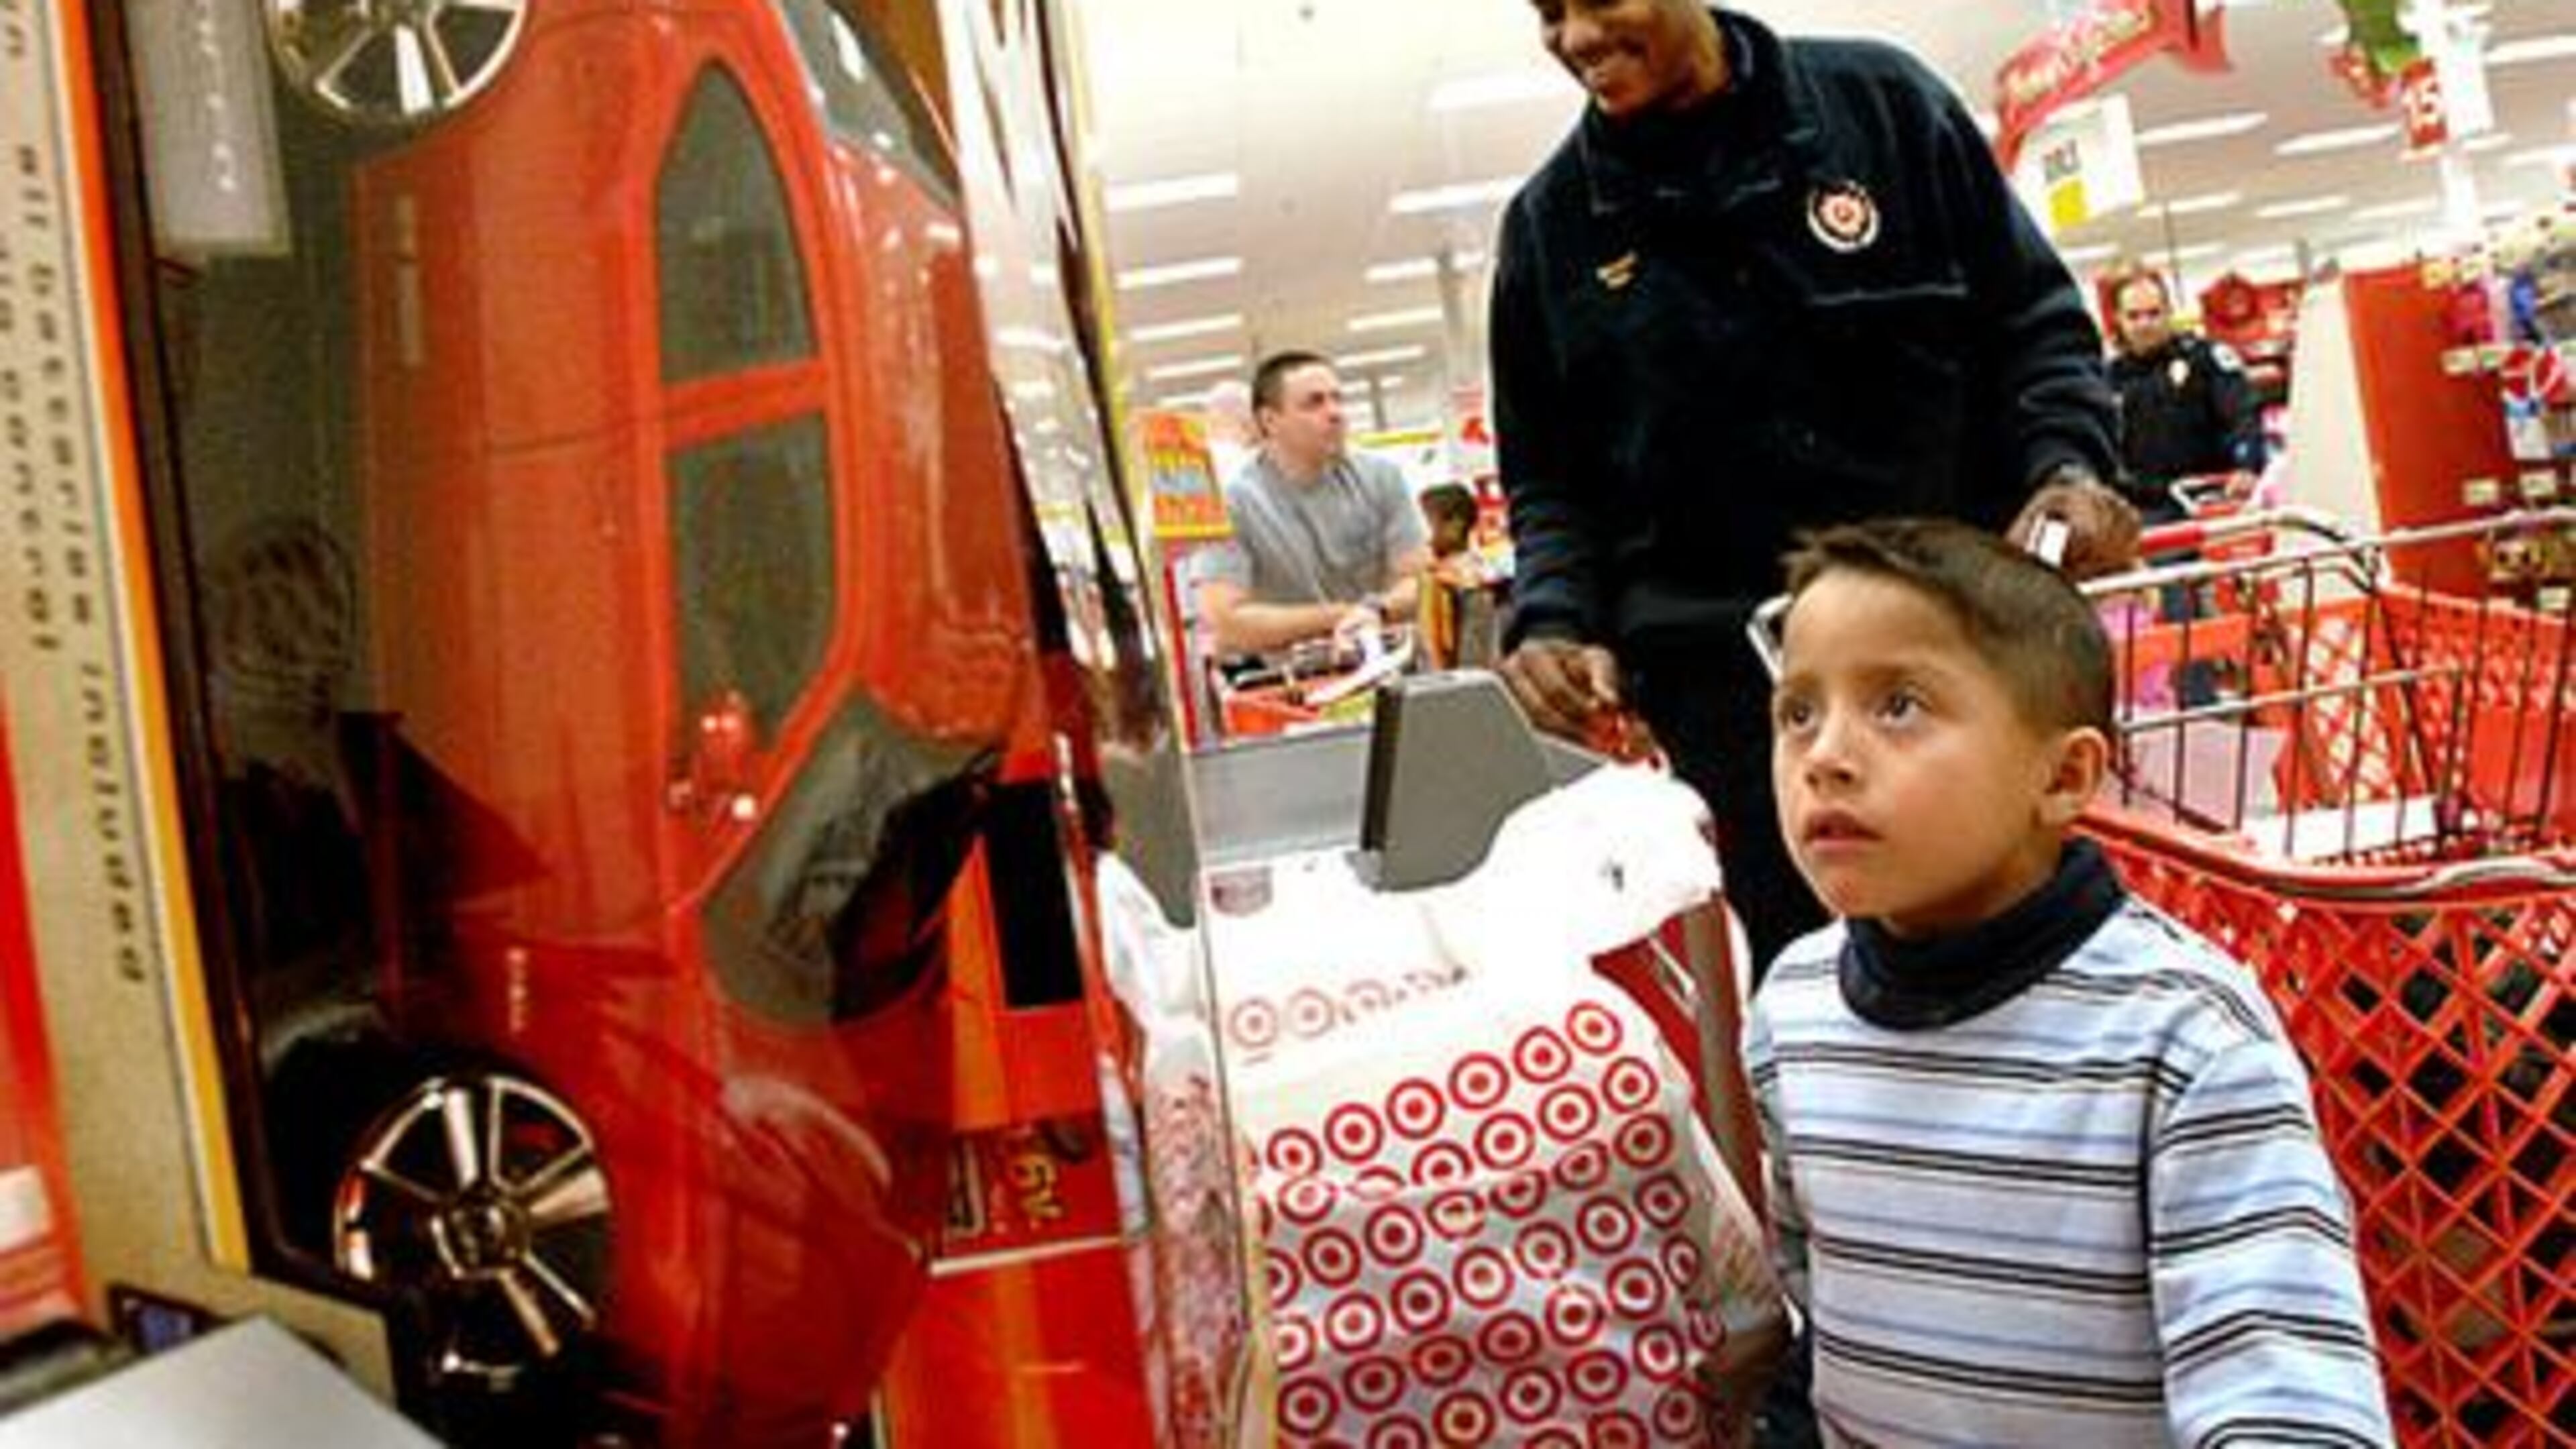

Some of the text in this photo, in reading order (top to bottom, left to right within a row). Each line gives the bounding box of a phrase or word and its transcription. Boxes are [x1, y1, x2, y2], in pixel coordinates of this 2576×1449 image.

[1, 369, 60, 650] control
[17, 145, 145, 982] all batteries included
